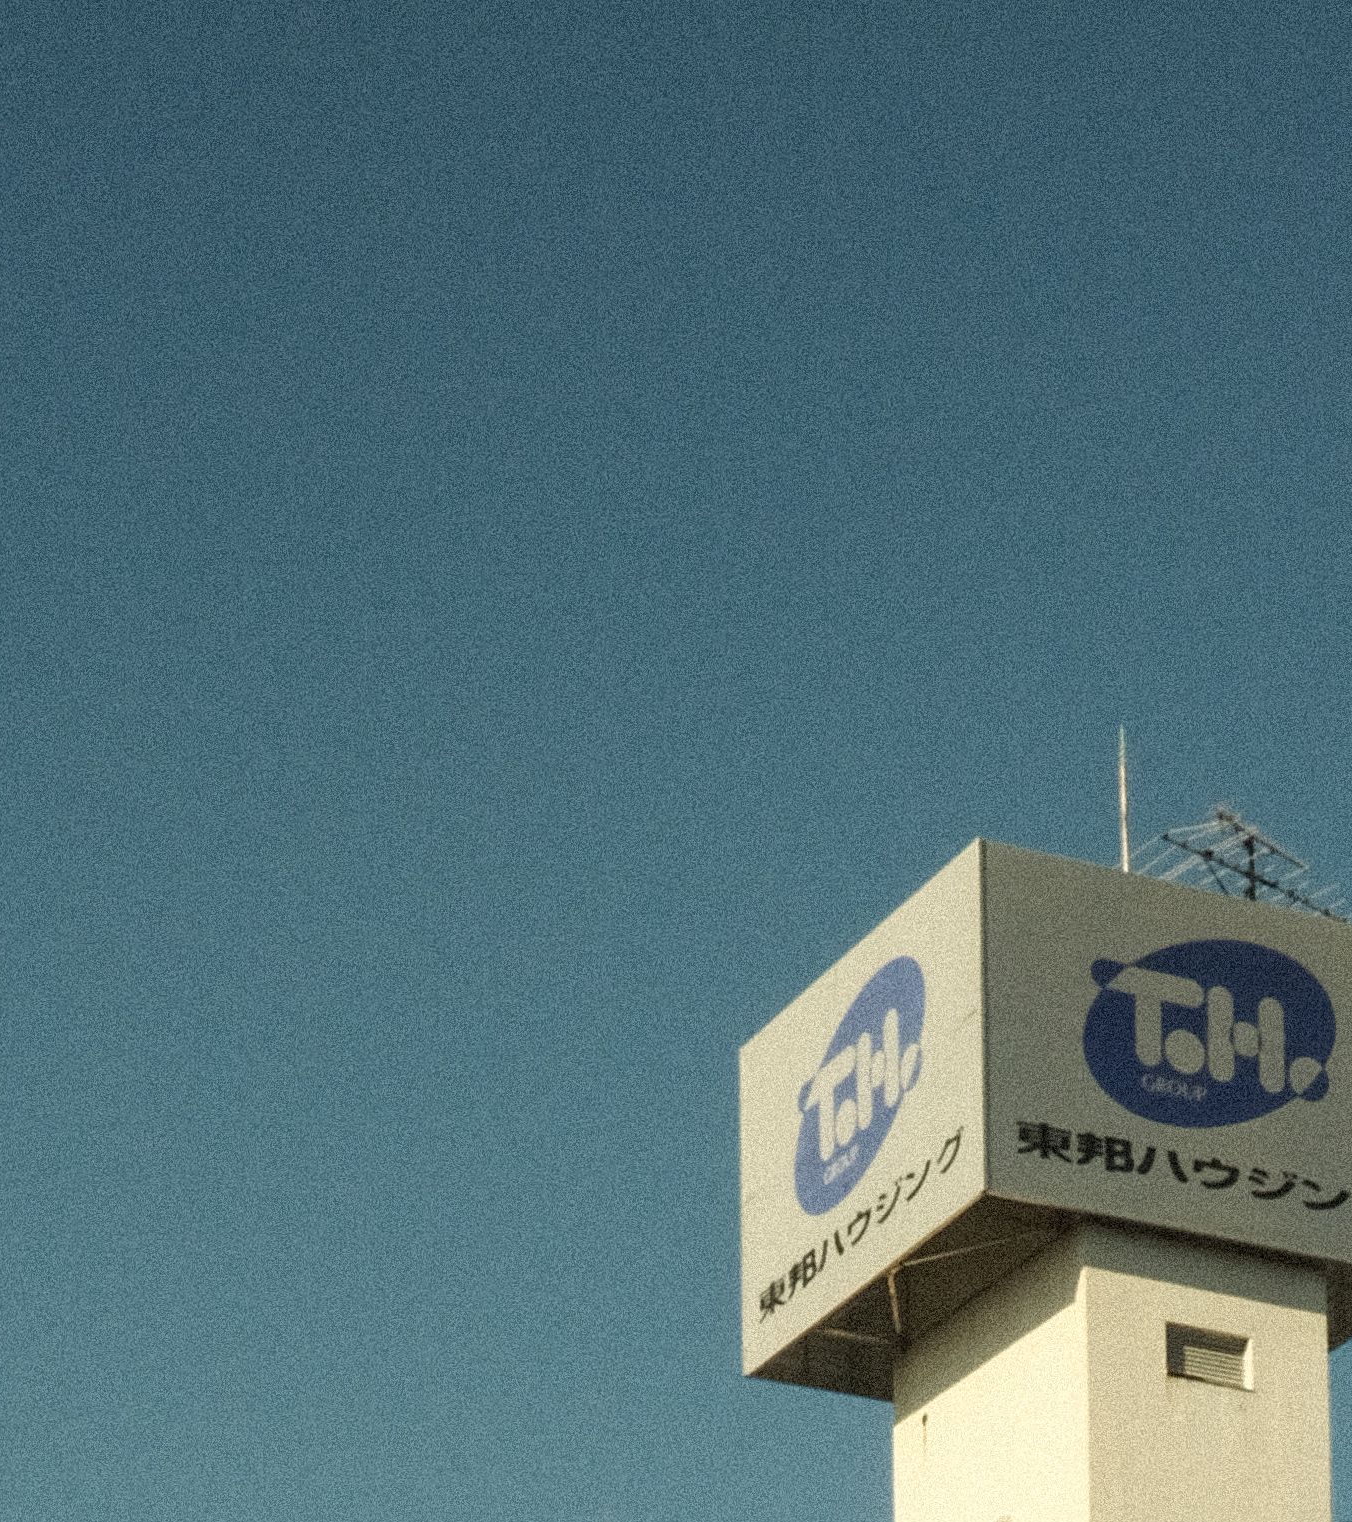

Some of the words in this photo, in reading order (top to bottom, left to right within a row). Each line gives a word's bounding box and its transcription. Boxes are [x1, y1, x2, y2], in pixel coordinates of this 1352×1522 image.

[758, 1124, 965, 1324] 東邦ハウジング
